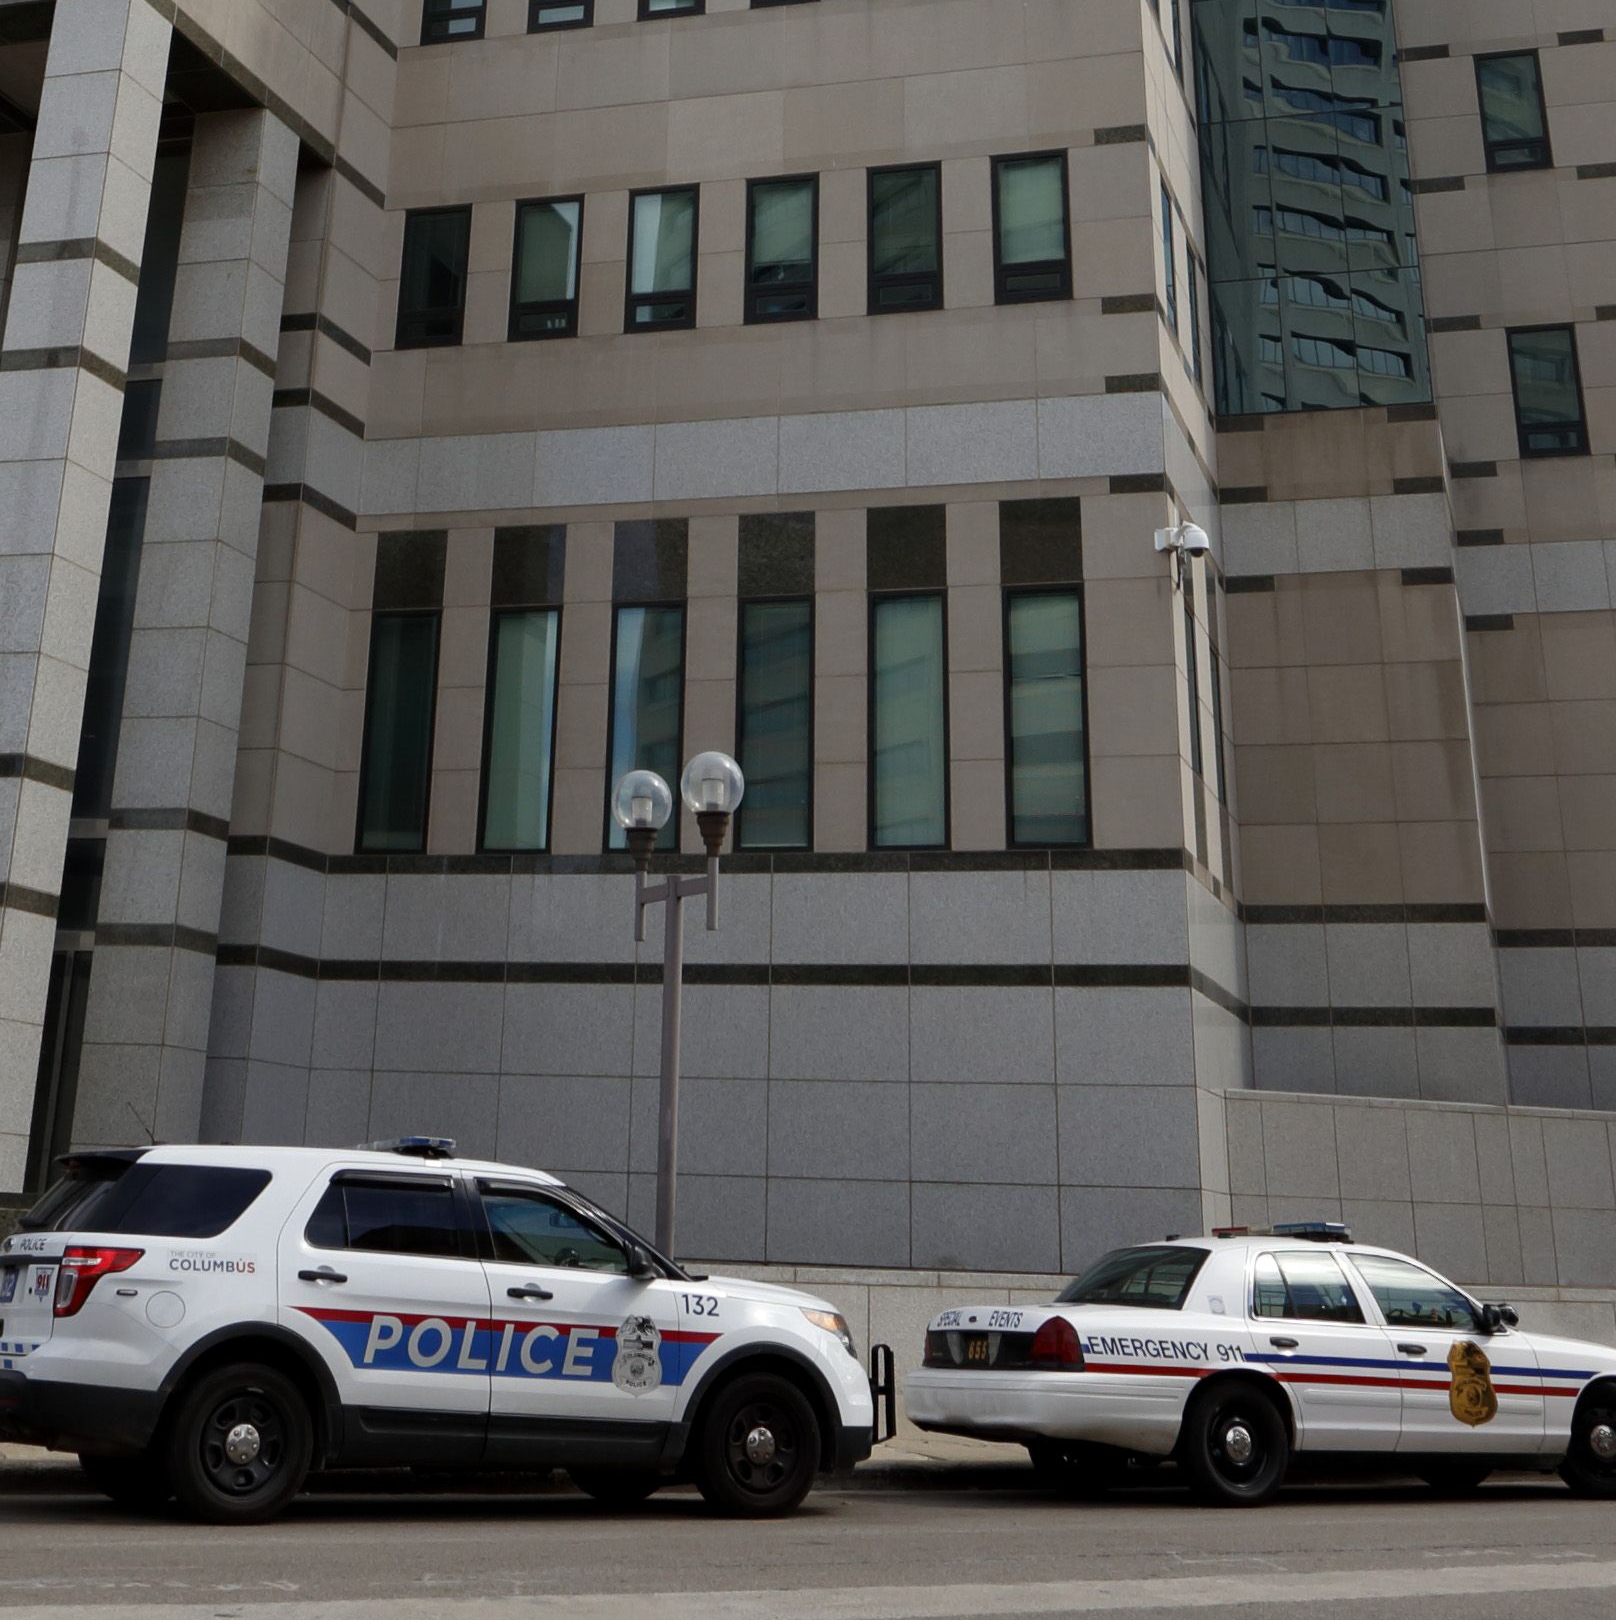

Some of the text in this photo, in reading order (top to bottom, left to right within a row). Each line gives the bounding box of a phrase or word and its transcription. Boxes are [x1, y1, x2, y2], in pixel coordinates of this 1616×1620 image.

[19, 1238, 47, 1251] POLICE
[170, 1250, 184, 1258] THE
[186, 1251, 204, 1259] CITY
[169, 1257, 255, 1274] COLUMBUS
[36, 1274, 50, 1291] 911
[682, 1294, 720, 1317] 132
[936, 1310, 1024, 1328] SPECIAL EVENTS
[363, 1314, 600, 1376] POLICE
[1086, 1336, 1246, 1363] EMERGENCY 911
[625, 1379, 647, 1389] POLICE
